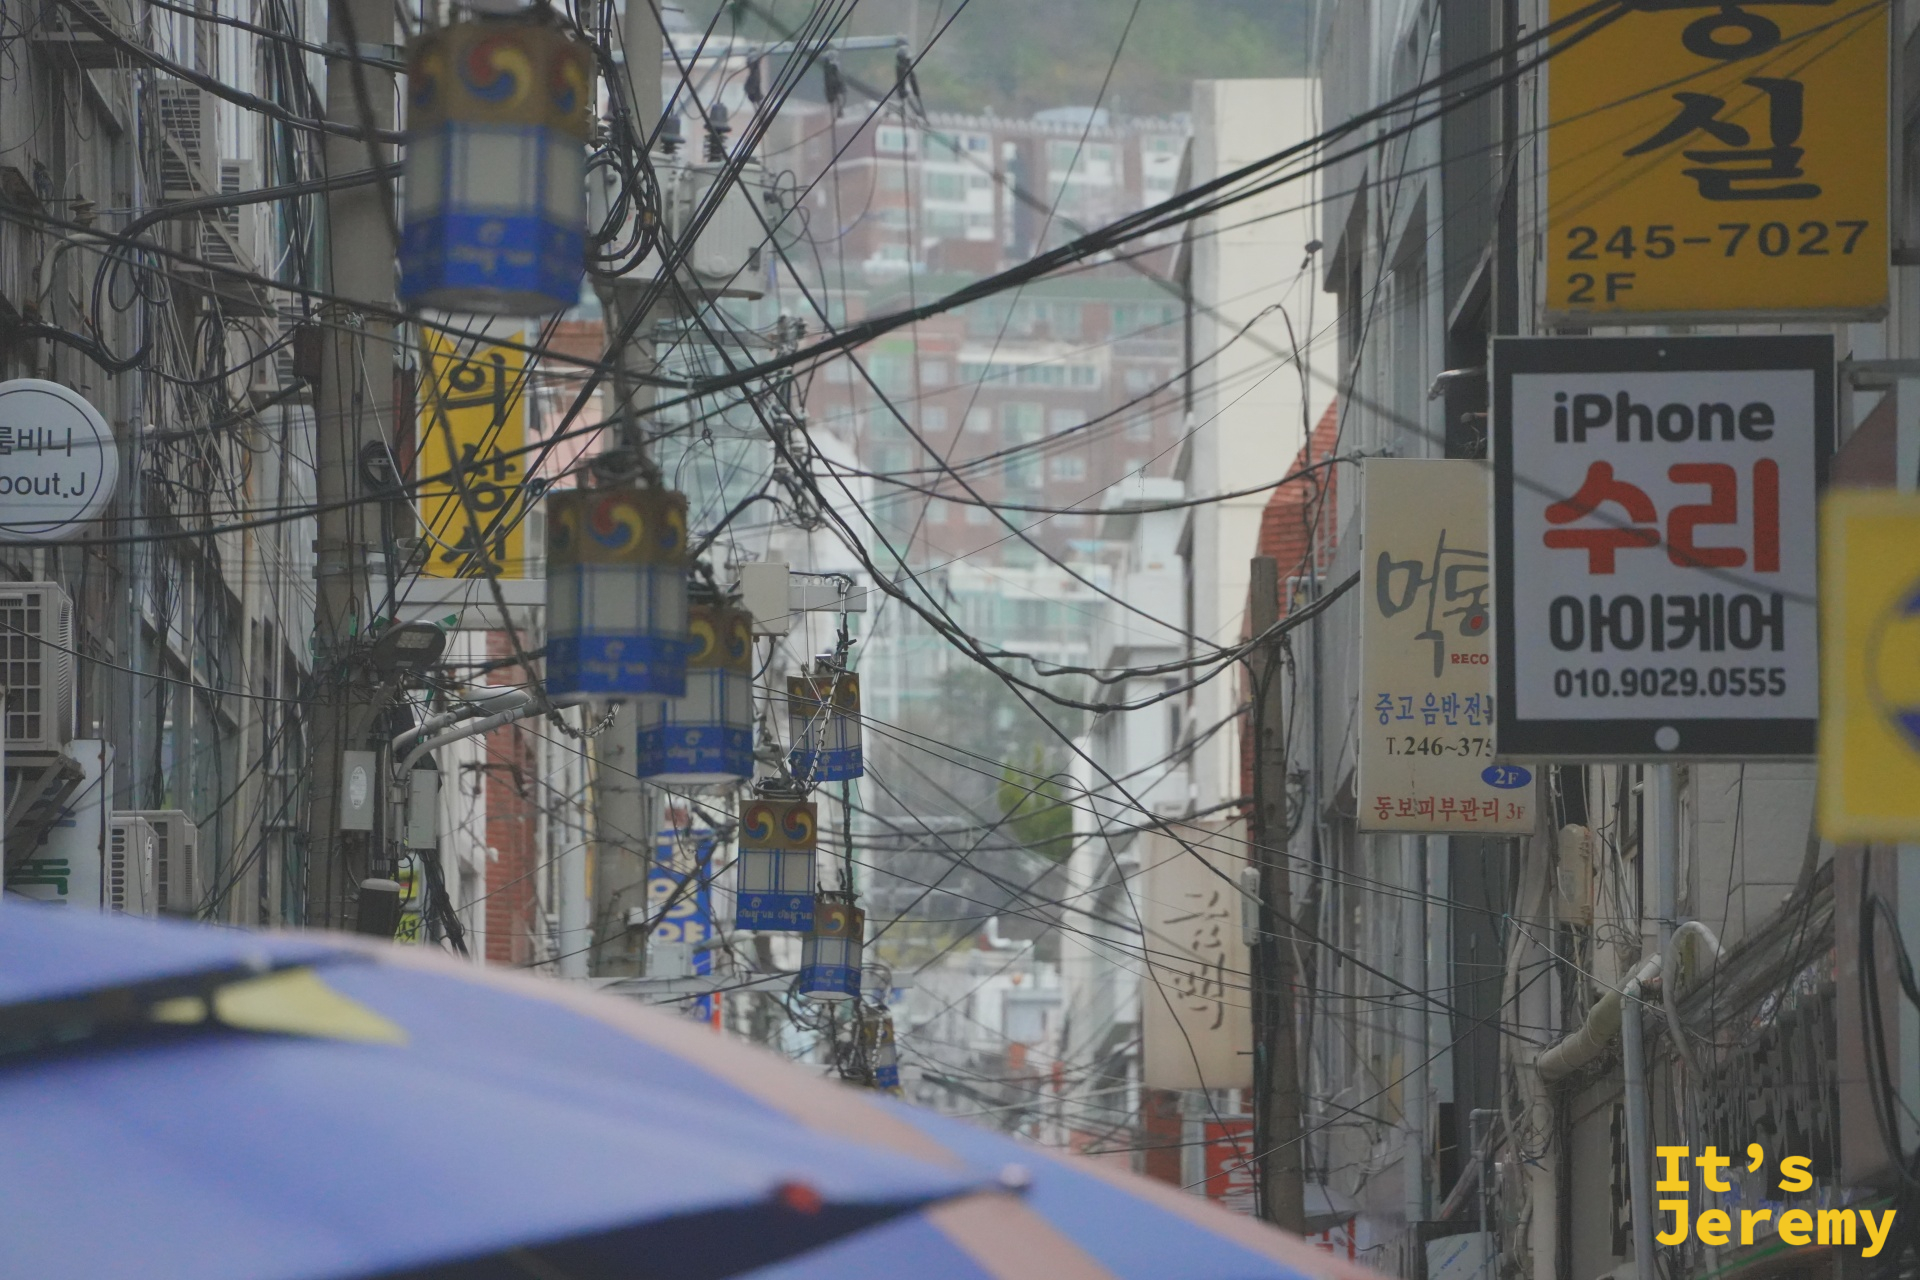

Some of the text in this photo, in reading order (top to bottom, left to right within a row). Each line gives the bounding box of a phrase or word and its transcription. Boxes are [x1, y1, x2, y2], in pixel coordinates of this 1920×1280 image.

[1566, 221, 1869, 260] 245-7027
[1566, 273, 1636, 303] 2F
[1554, 390, 1775, 443] iPhone
[1543, 457, 1780, 574] 수리
[1550, 592, 1784, 651] 아이케어
[1451, 653, 1489, 665] RECO
[1554, 667, 1786, 698] 010.9029.0555
[1374, 692, 1494, 726] 중고 음반 전
[1494, 768, 1519, 785] 2F
[1505, 803, 1526, 820] 3F
